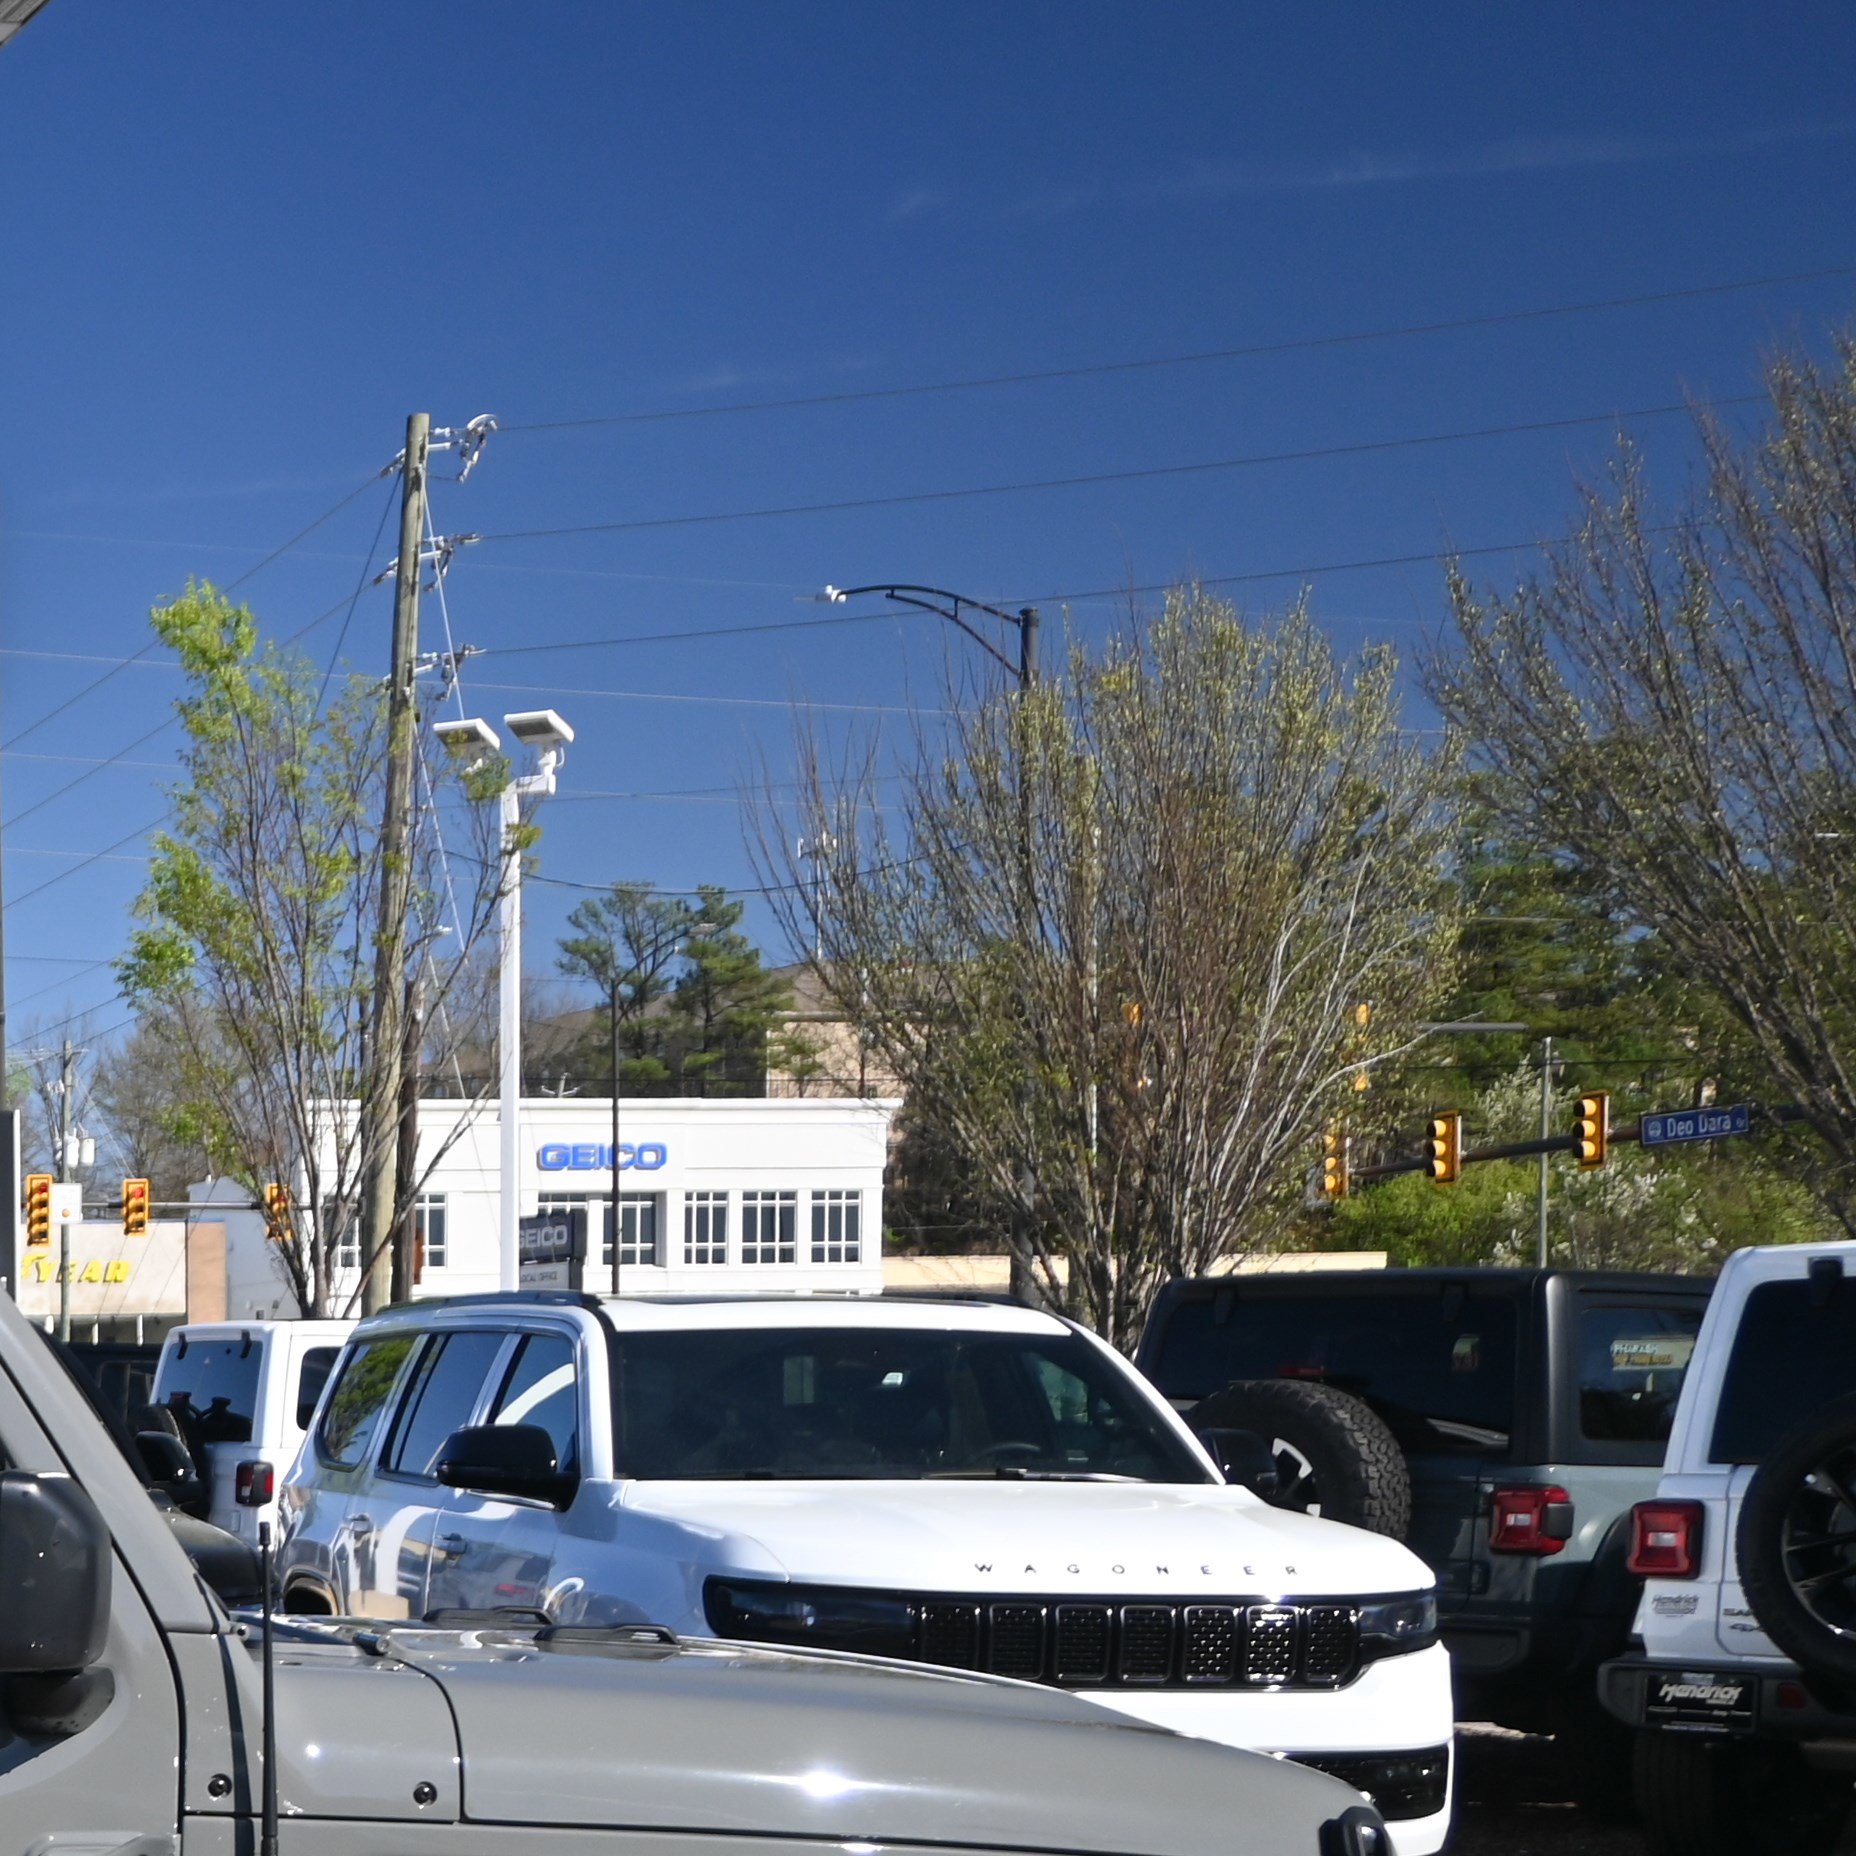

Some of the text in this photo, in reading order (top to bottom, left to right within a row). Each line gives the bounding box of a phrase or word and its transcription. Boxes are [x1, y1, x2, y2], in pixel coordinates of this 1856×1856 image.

[1667, 1117, 1694, 1137] Deo
[1698, 1115, 1732, 1133] Dara
[537, 1143, 667, 1171] GEICO
[974, 1563, 1298, 1575] WAGONEER
[1658, 1684, 1744, 1703] Hendrick
